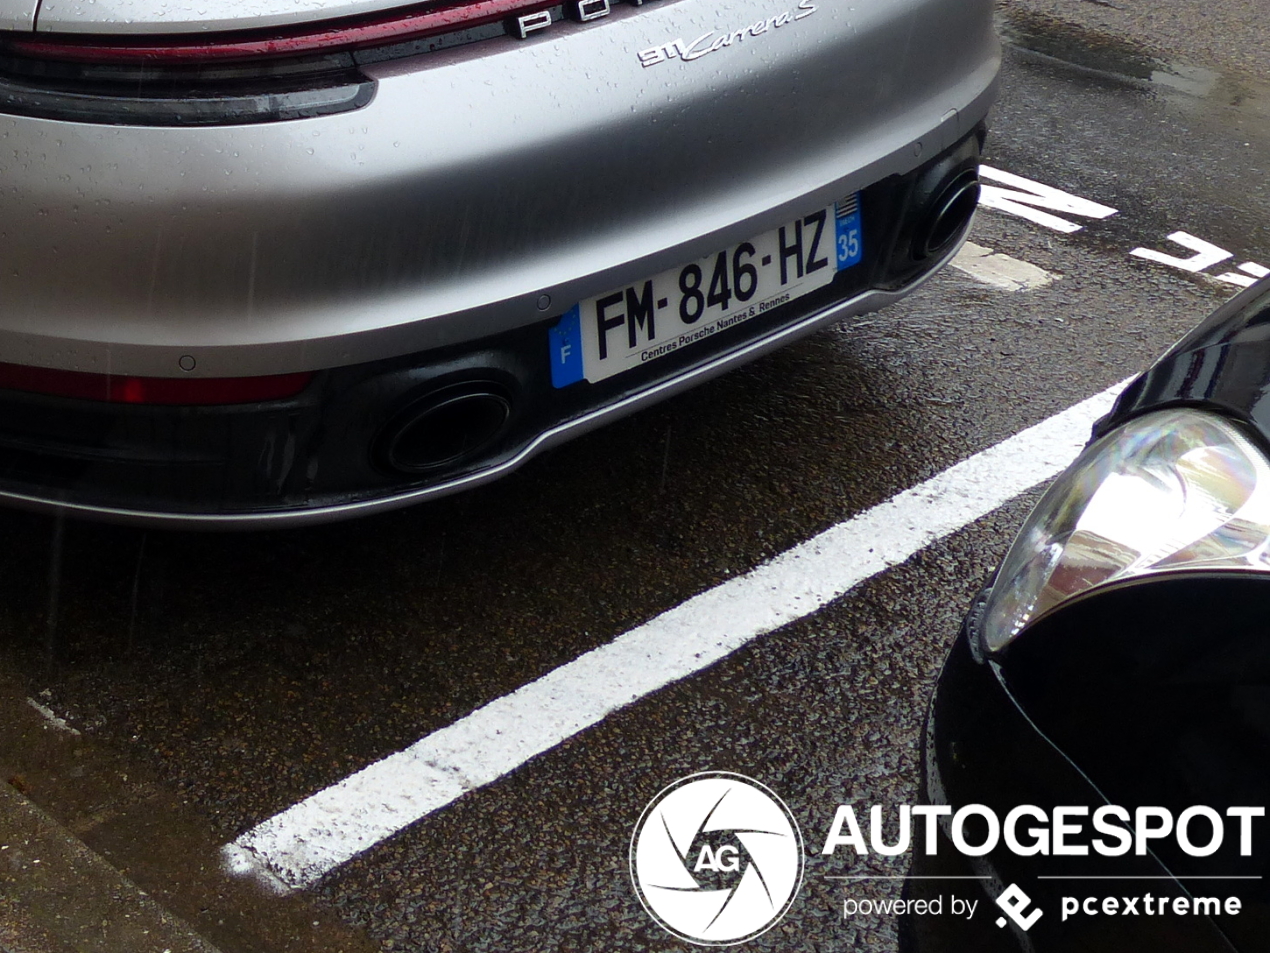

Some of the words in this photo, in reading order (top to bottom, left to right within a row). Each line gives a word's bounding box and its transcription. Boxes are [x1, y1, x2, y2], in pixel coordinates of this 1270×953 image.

[638, 38, 685, 67] 911
[680, 7, 793, 61] Carrera
[838, 229, 859, 261] 35
[595, 209, 829, 361] FM-846-HZ
[560, 345, 571, 364] F
[641, 341, 677, 362] Centres
[679, 324, 715, 346] Porsche
[716, 311, 747, 331] Nantes
[749, 306, 755, 316] &
[759, 292, 790, 312] Rennes
